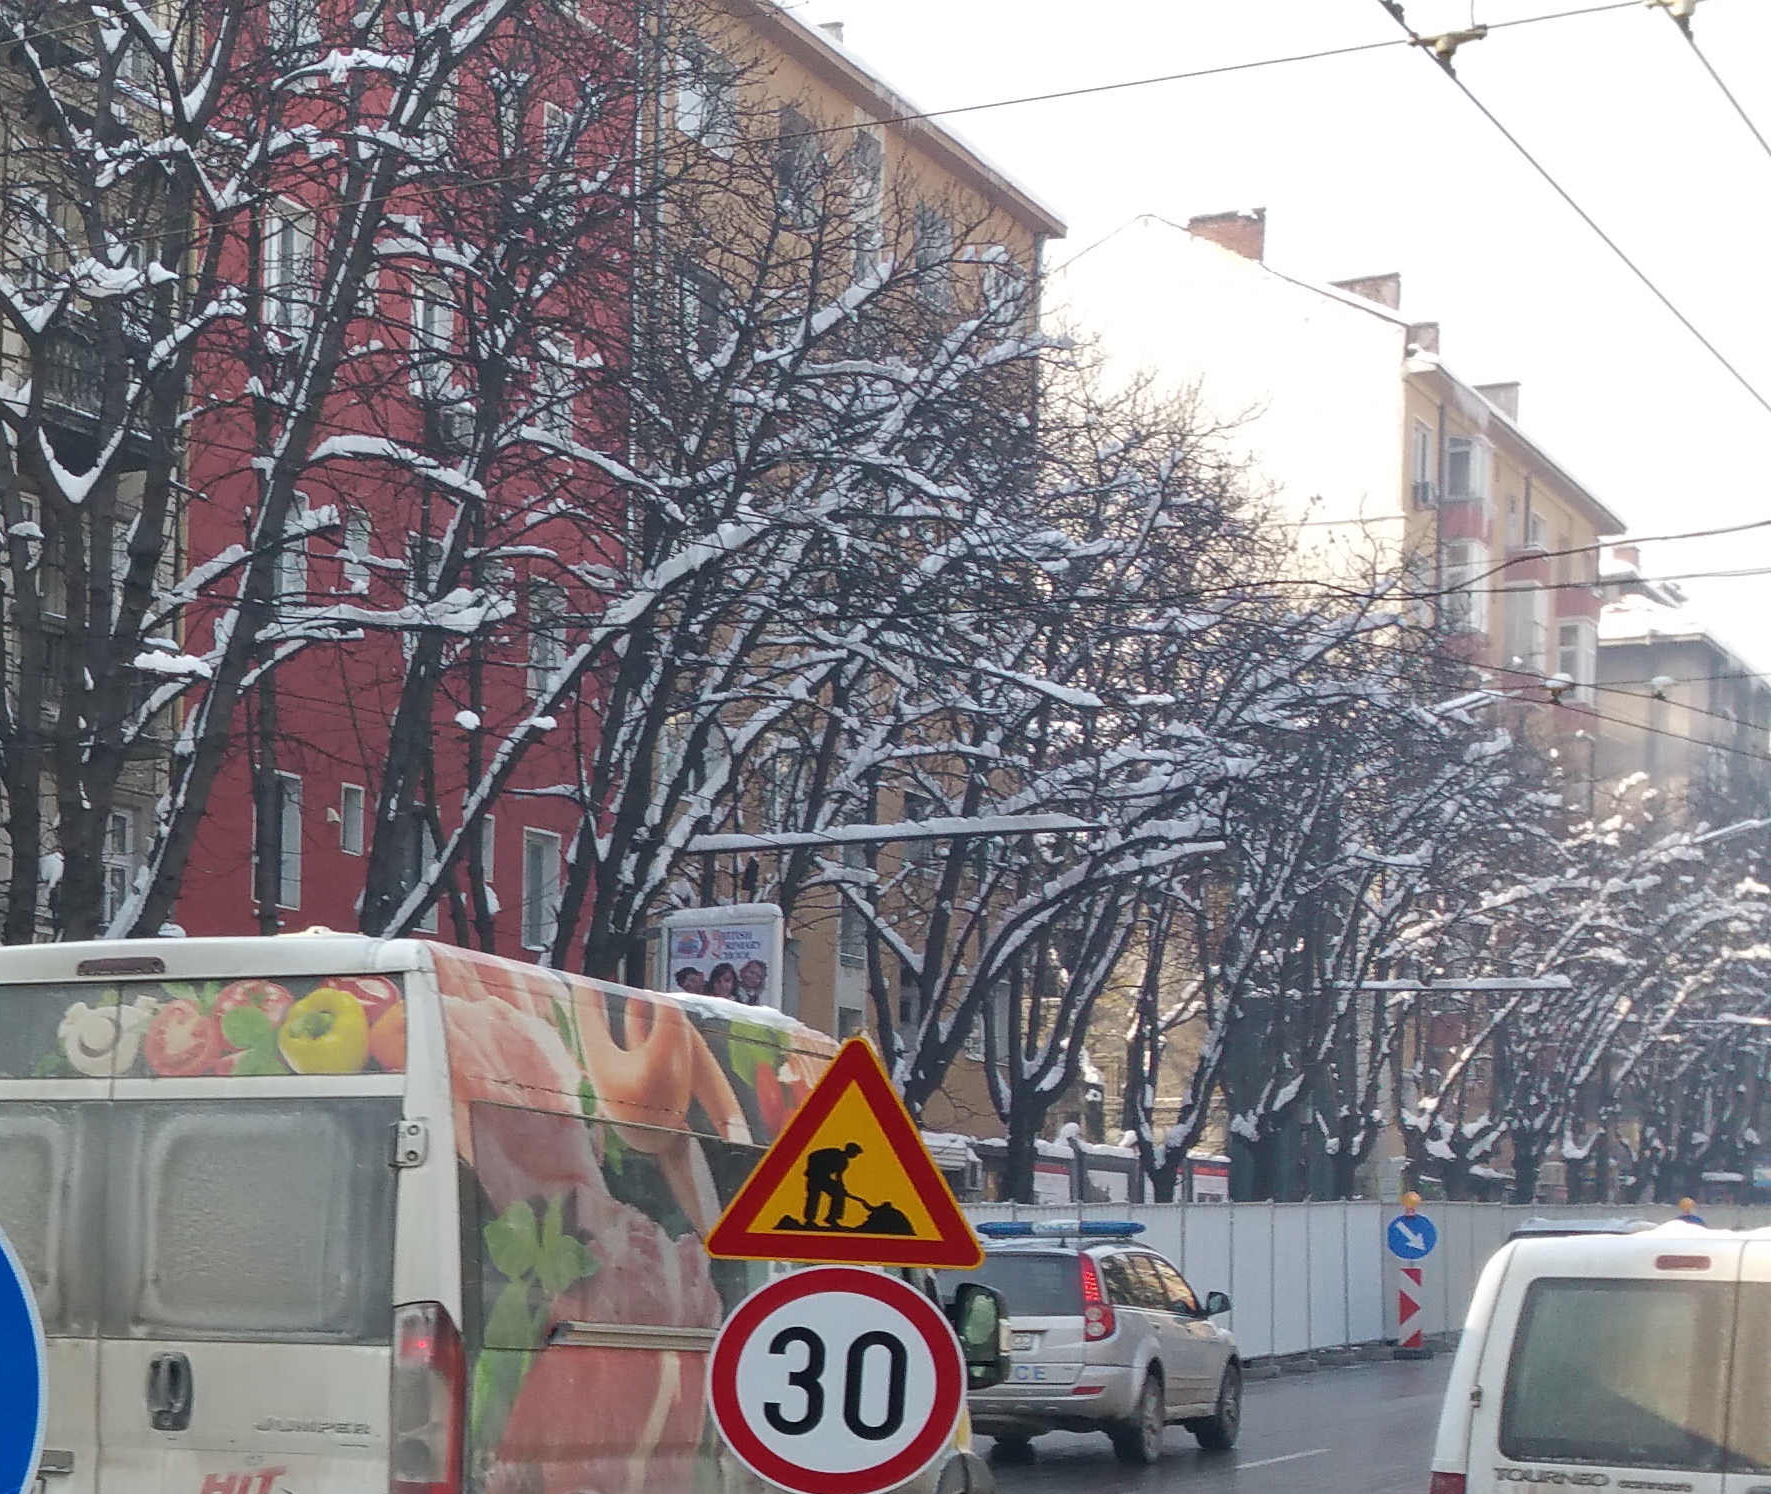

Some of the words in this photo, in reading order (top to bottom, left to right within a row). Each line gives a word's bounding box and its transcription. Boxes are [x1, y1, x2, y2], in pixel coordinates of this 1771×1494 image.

[763, 1326, 908, 1441] 30
[253, 1416, 371, 1435] JUMPER
[1494, 1467, 1609, 1487] TOURNEO
